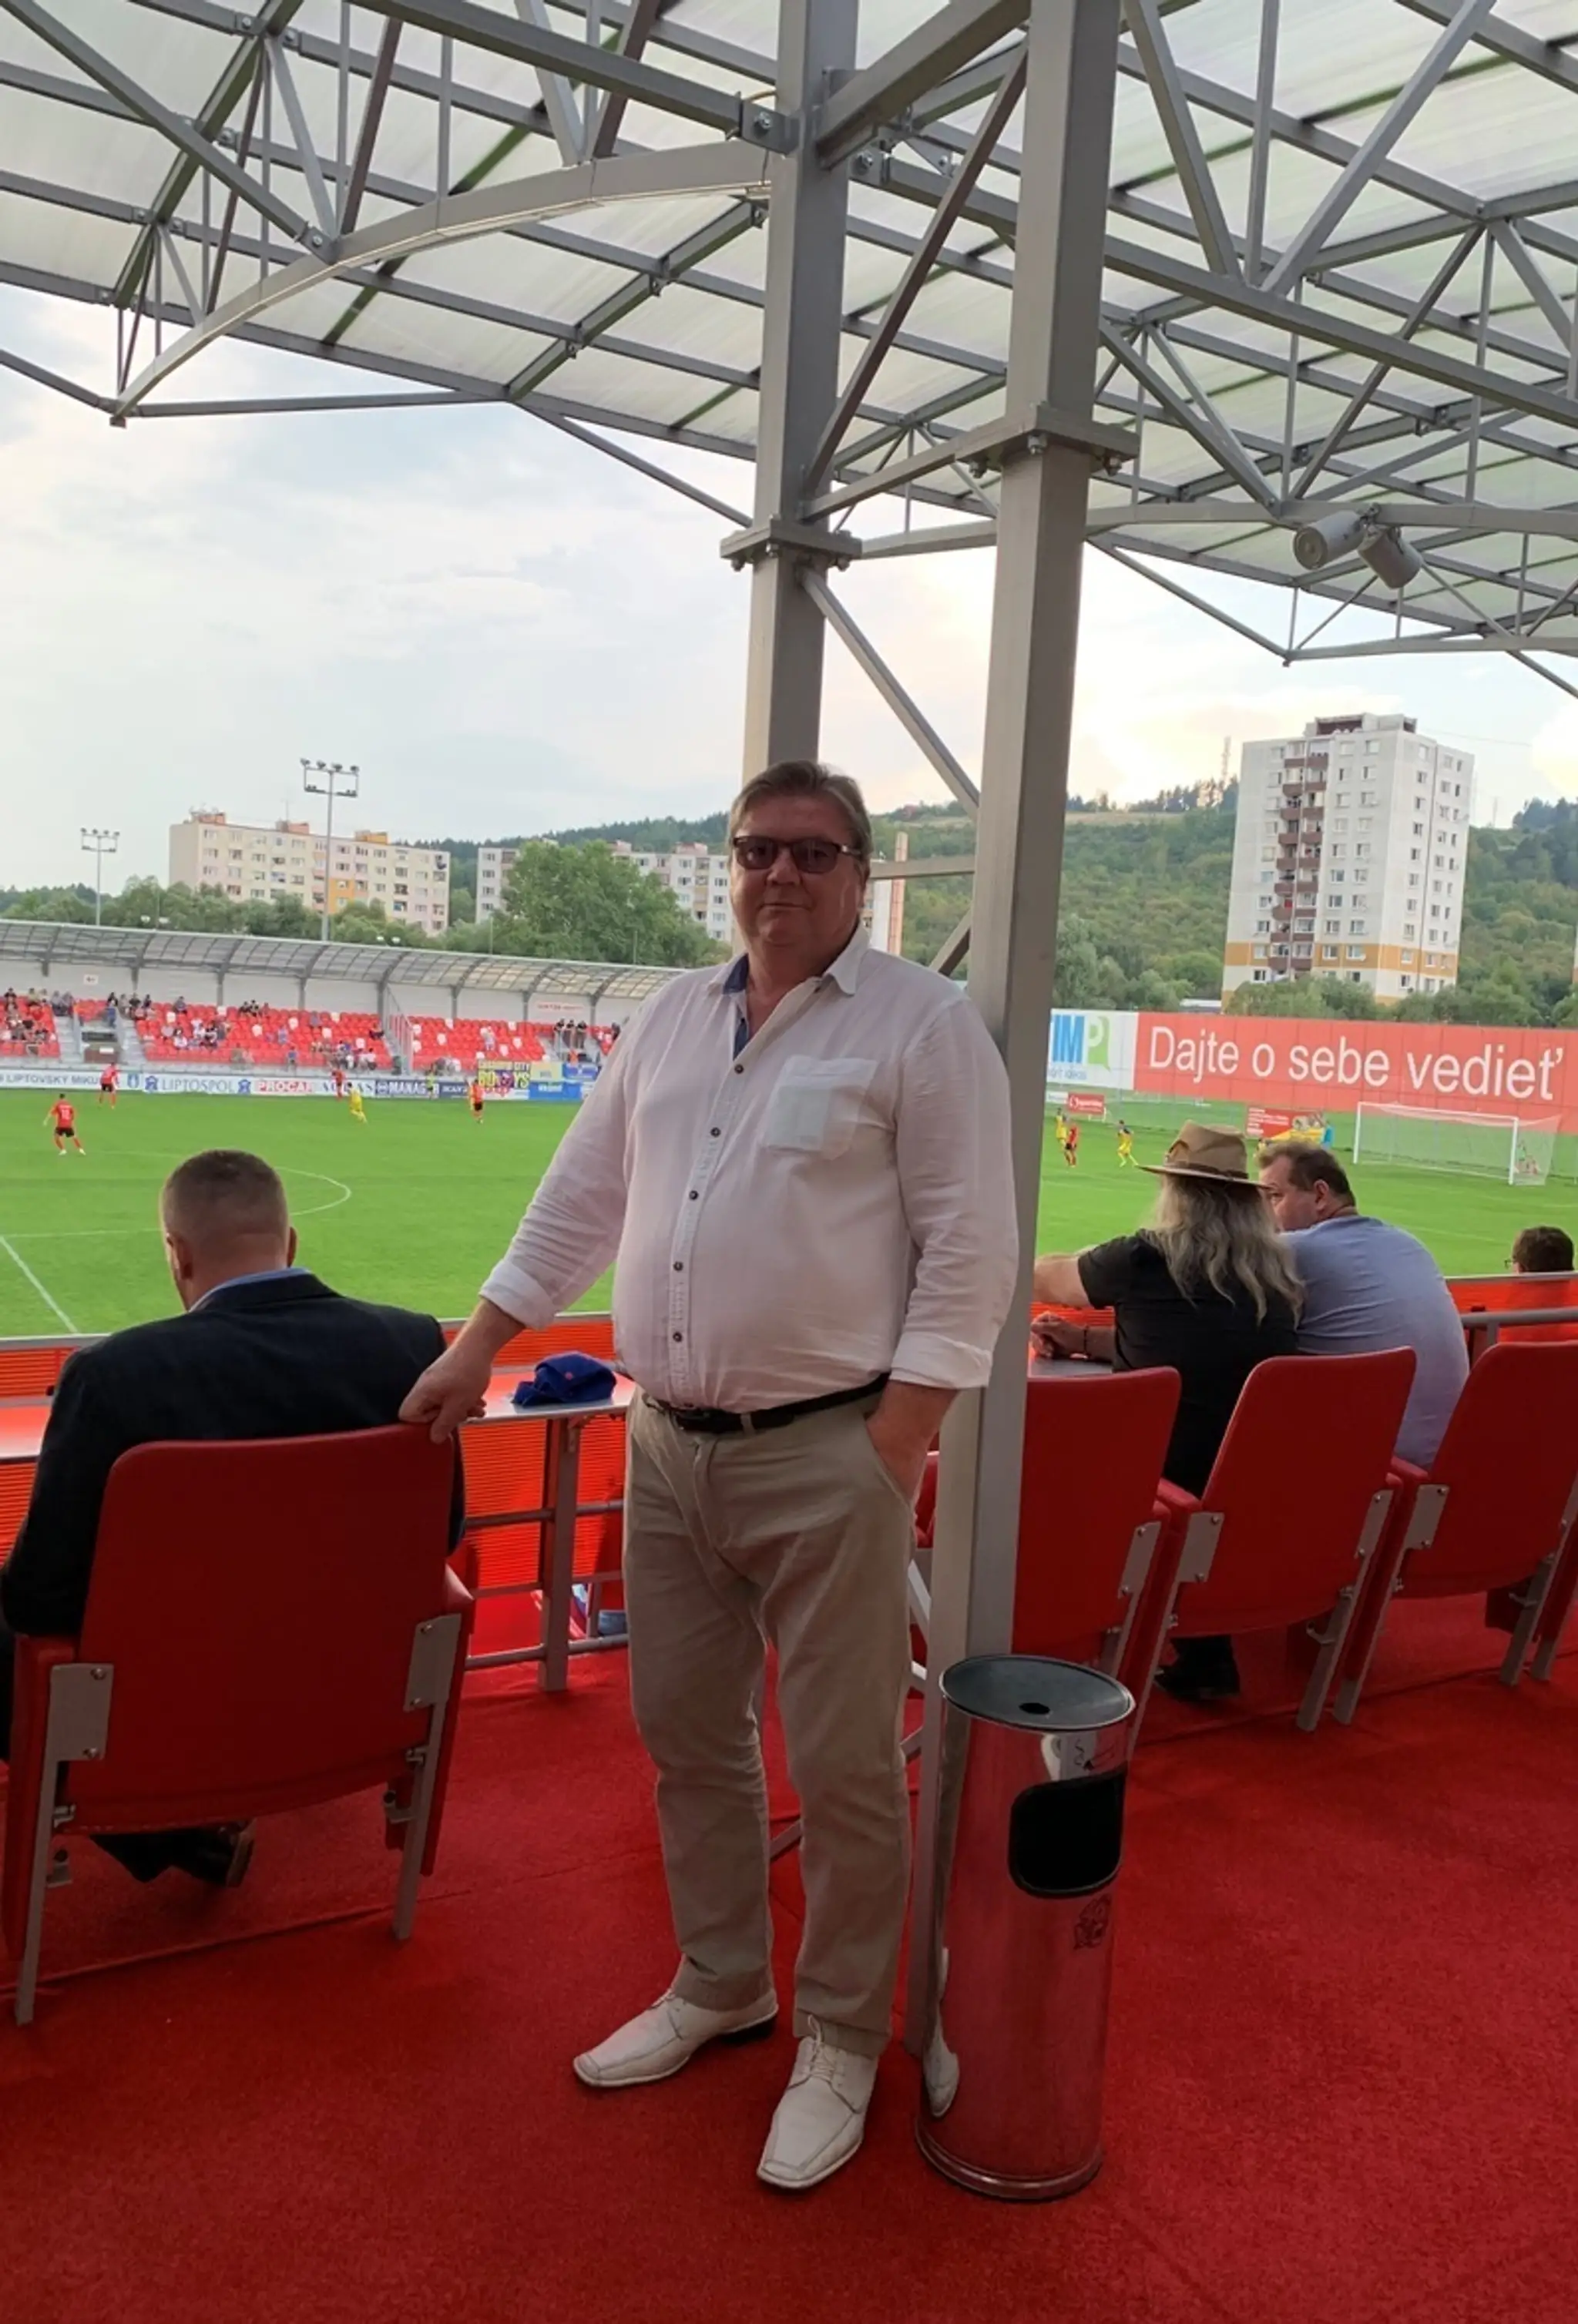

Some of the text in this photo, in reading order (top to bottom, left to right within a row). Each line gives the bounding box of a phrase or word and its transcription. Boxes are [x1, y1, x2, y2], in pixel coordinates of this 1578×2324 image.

[1149, 1026, 1240, 1083] Dajte
[1251, 1043, 1275, 1077] o
[1288, 1035, 1390, 1087] sebe
[161, 1078, 235, 1092] LIPTOSPOL
